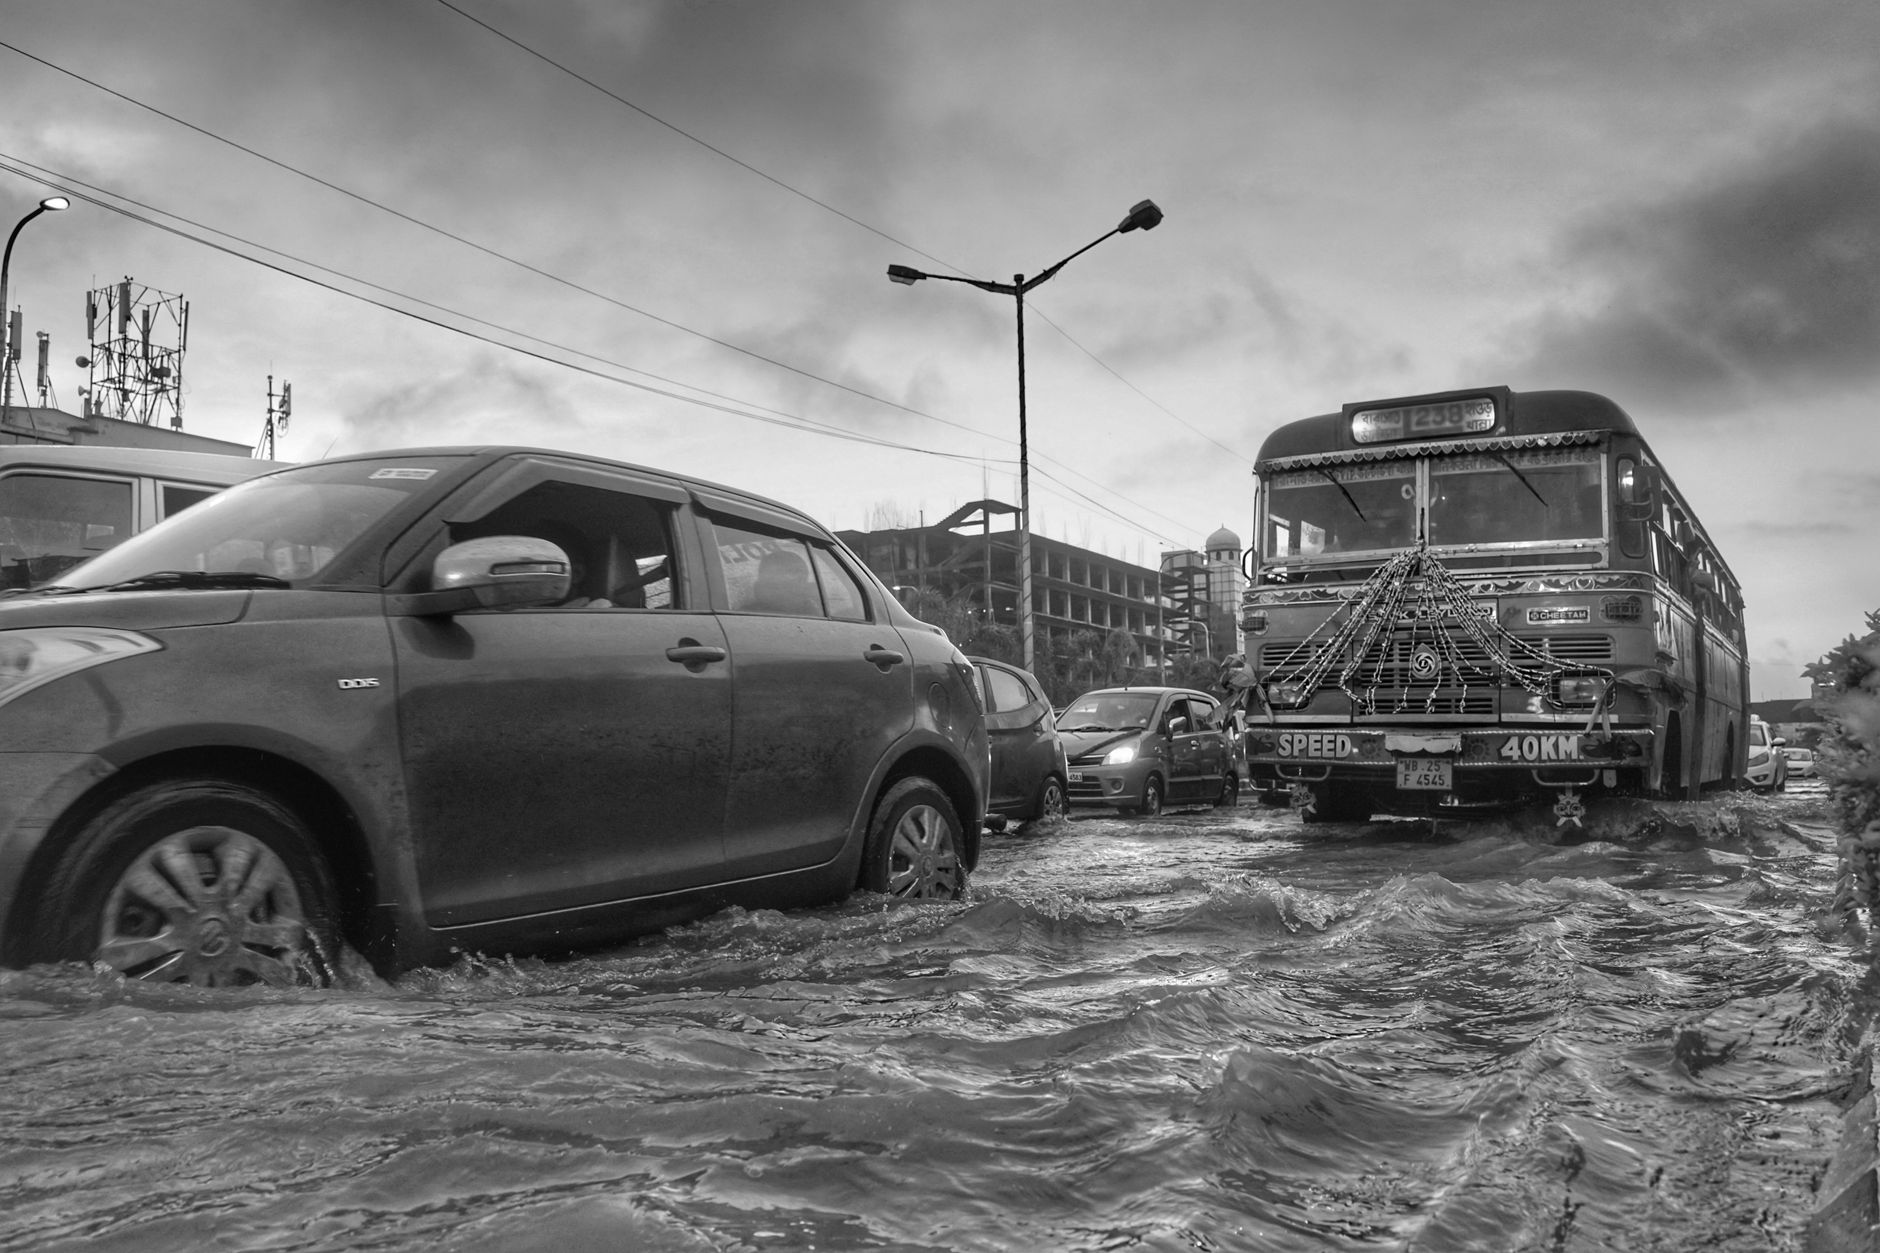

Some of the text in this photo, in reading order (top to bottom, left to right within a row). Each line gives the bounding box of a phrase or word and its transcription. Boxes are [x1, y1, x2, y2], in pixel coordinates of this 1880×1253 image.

[1415, 404, 1464, 428] 238
[1540, 611, 1586, 620] CHEETAH
[1278, 733, 1351, 758] SPEED
[1404, 774, 1445, 786] F 4545
